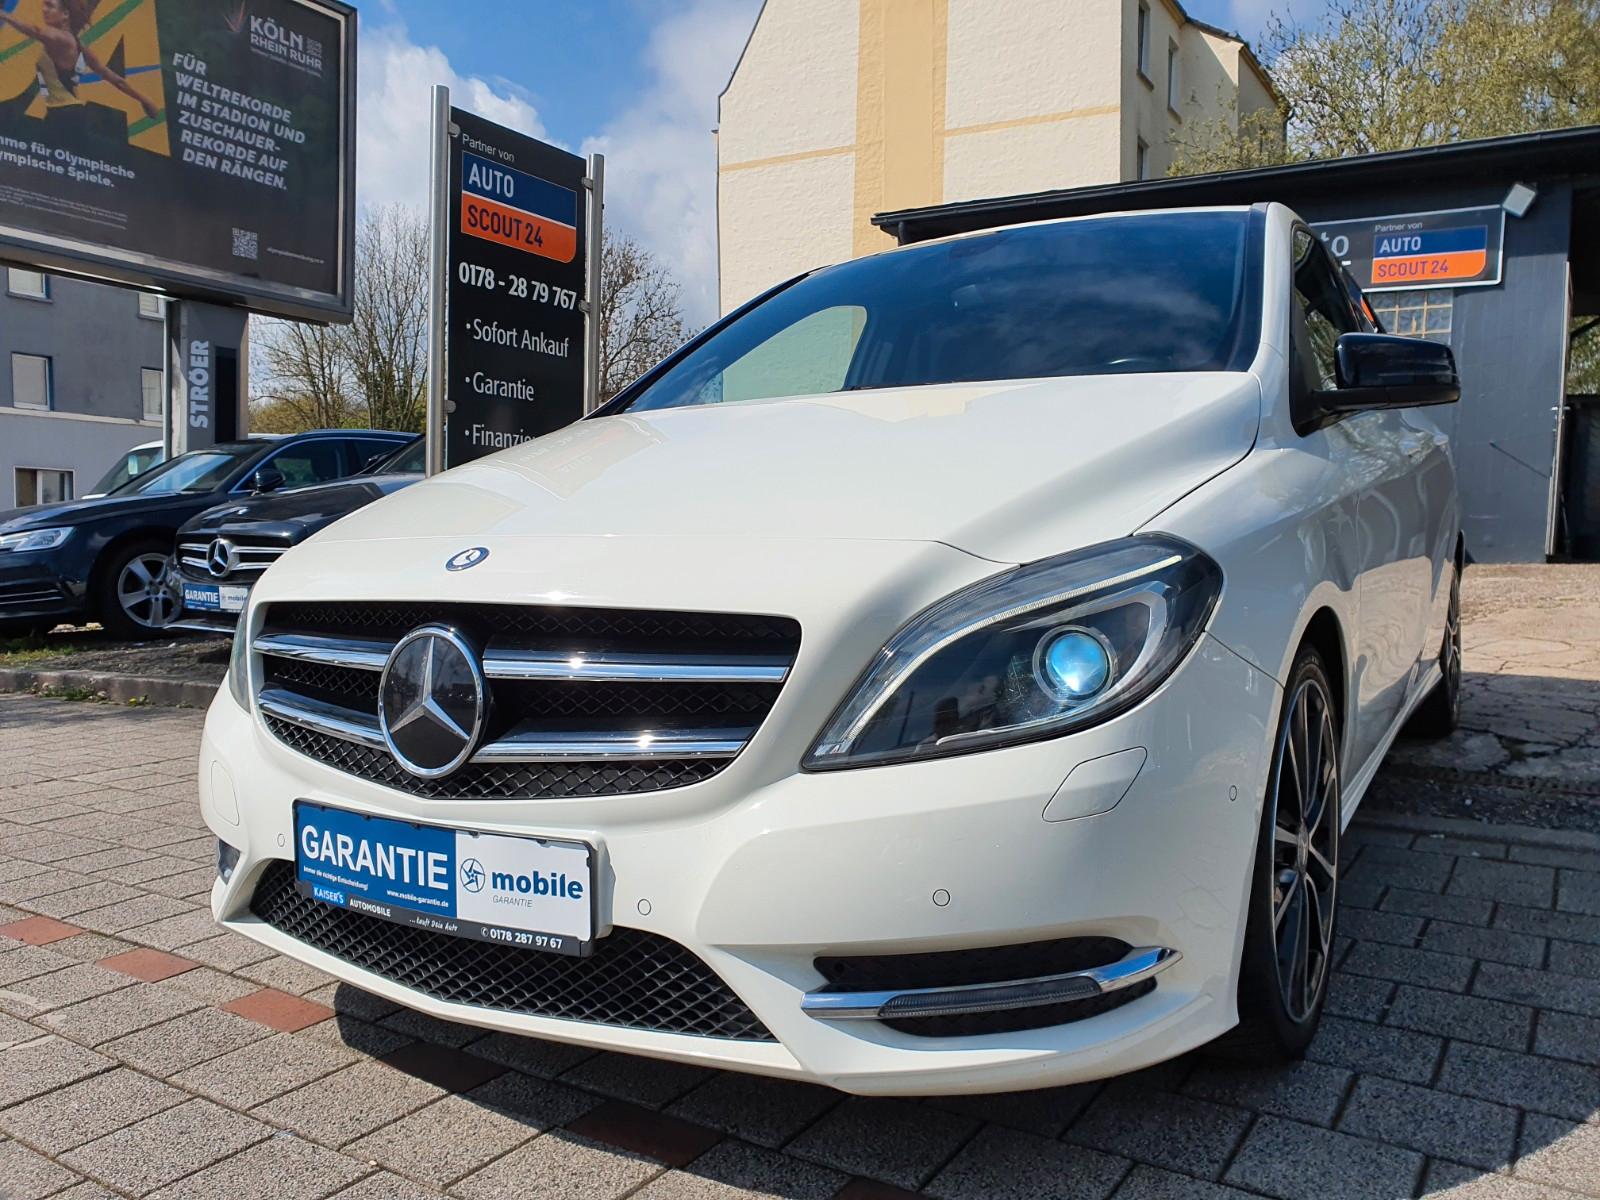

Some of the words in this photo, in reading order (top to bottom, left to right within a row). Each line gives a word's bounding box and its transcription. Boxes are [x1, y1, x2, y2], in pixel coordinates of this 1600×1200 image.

[250, 15, 303, 50] KÖLN
[172, 52, 207, 76] FÜR
[250, 33, 287, 56] RHEIN
[290, 49, 322, 70] RUHR
[176, 72, 292, 124] WELTREKORDE
[176, 91, 198, 109] IM
[200, 100, 270, 134] STADION
[274, 123, 306, 144] UND
[178, 110, 281, 152] ZUSCHAUER-
[31, 142, 52, 158] für
[54, 148, 136, 178] Olympische
[180, 129, 257, 164] REKORDE
[258, 154, 288, 172] AUF
[462, 133, 496, 156] Partner
[498, 150, 515, 163] von
[68, 166, 115, 188] Spiele.
[182, 148, 218, 169] DEN
[220, 160, 288, 190] RÄNGEN.
[468, 163, 514, 198] AUTO
[1374, 224, 1406, 232] Partner
[1408, 222, 1423, 230] von
[1380, 236, 1422, 254] AUTO
[458, 262, 494, 290] 0178
[508, 274, 528, 298] 28
[531, 280, 549, 303] 79
[552, 286, 577, 310] 767
[473, 318, 518, 348] Sofort
[520, 329, 569, 358] Ankauf
[188, 340, 208, 428] STRÖER
[472, 372, 535, 402] Garantie
[185, 589, 219, 603] GARANTIE
[302, 824, 449, 890] GARANTIE
[386, 889, 449, 908] www.mobile-garantie.de
[492, 870, 584, 900] mobile
[492, 894, 533, 908] GARANTIE
[349, 898, 392, 918] AUTOMOBILE
[490, 928, 512, 942] 0178
[515, 932, 532, 944] 287
[536, 936, 548, 948] 97
[550, 938, 562, 950] 67
